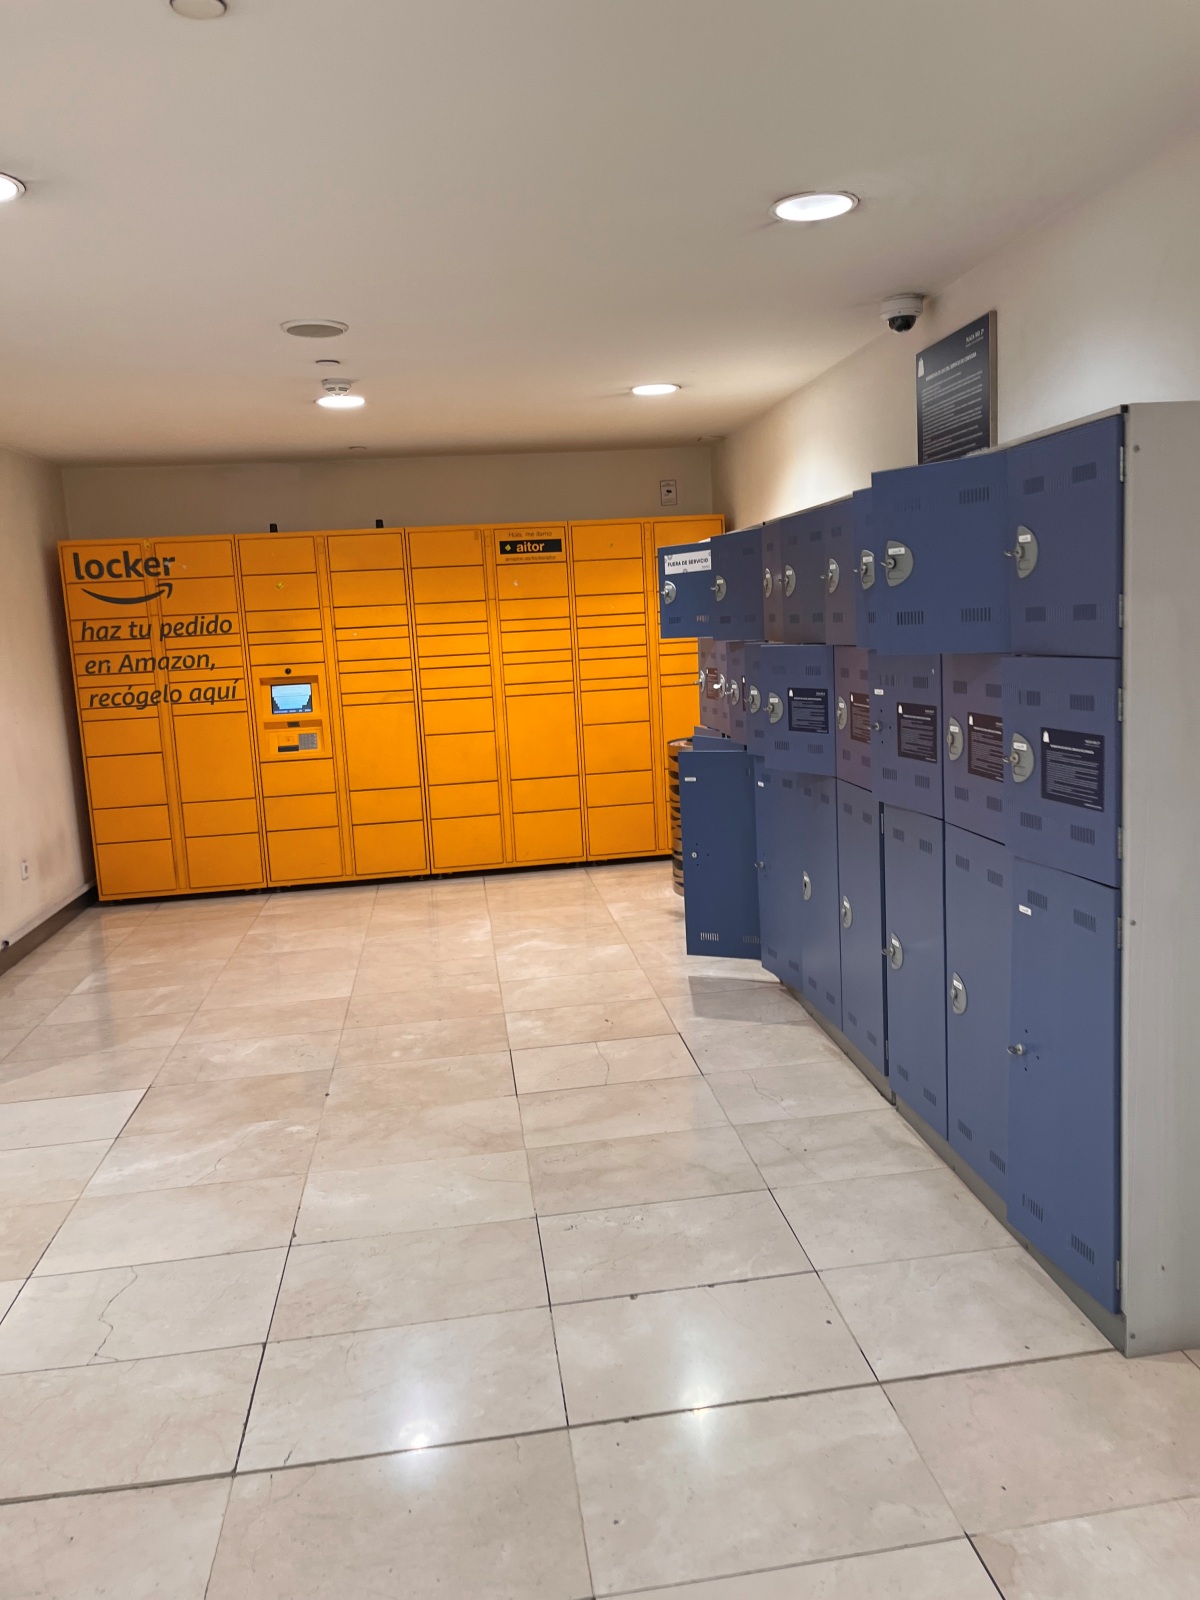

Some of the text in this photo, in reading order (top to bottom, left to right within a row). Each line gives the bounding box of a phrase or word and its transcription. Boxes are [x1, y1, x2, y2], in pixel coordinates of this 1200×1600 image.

[516, 541, 545, 553] aitor
[73, 550, 176, 580] locker
[688, 557, 709, 565] SERVICIO
[81, 615, 233, 642] haz tu pedido
[85, 653, 216, 675] en Amazon,
[89, 678, 240, 710] recógelo aquí
